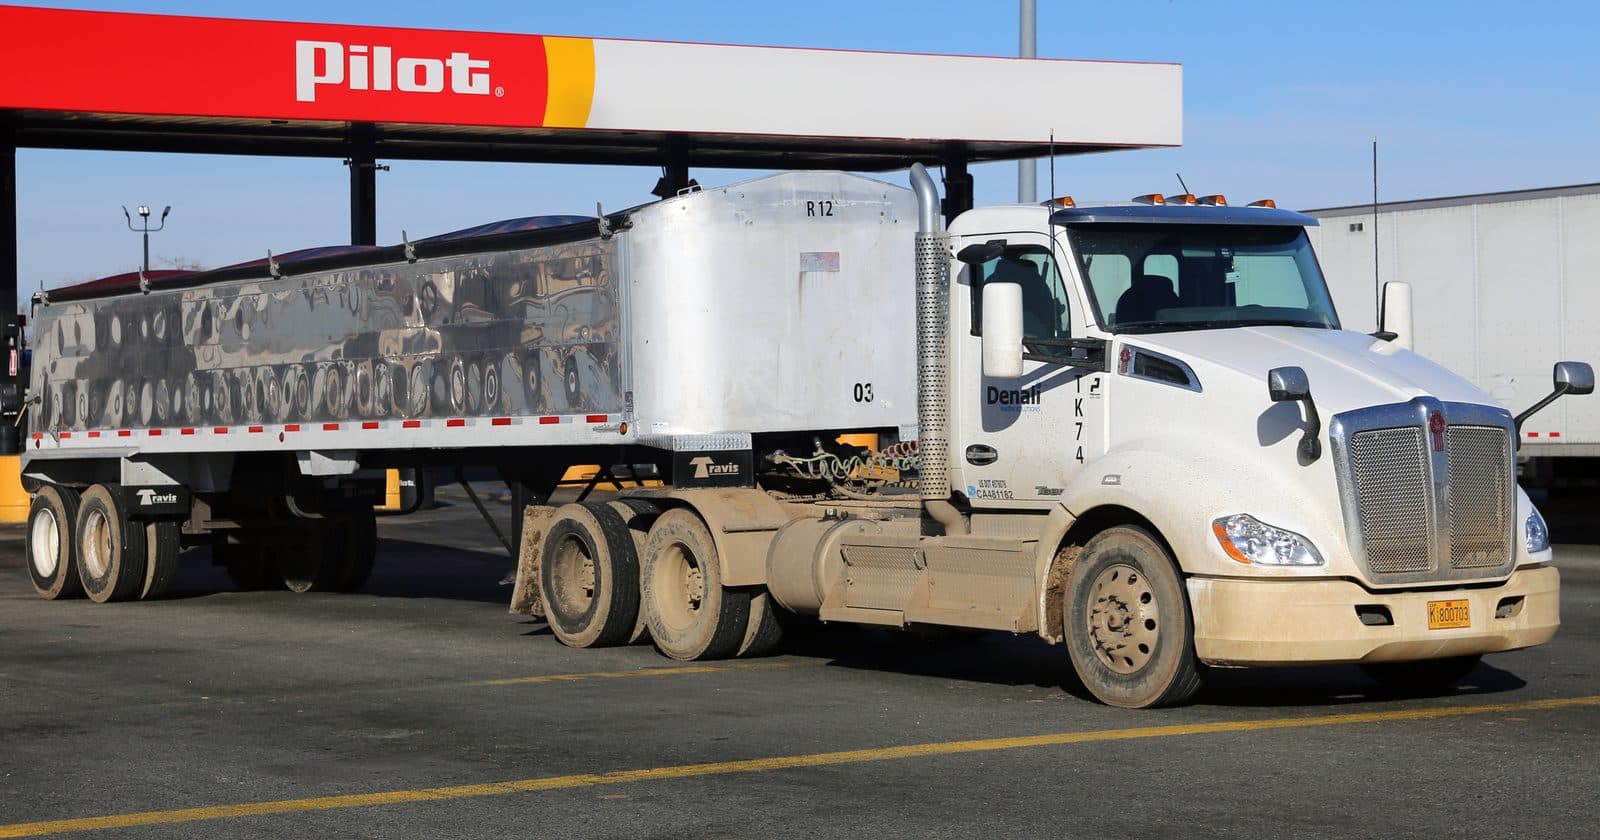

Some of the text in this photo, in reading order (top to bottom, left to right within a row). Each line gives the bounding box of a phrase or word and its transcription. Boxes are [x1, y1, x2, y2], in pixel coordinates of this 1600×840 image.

[807, 200, 833, 217] R 12
[853, 382, 874, 403] 03
[987, 382, 1041, 405] Denali
[689, 456, 740, 478] Travis
[136, 489, 177, 506] Travis
